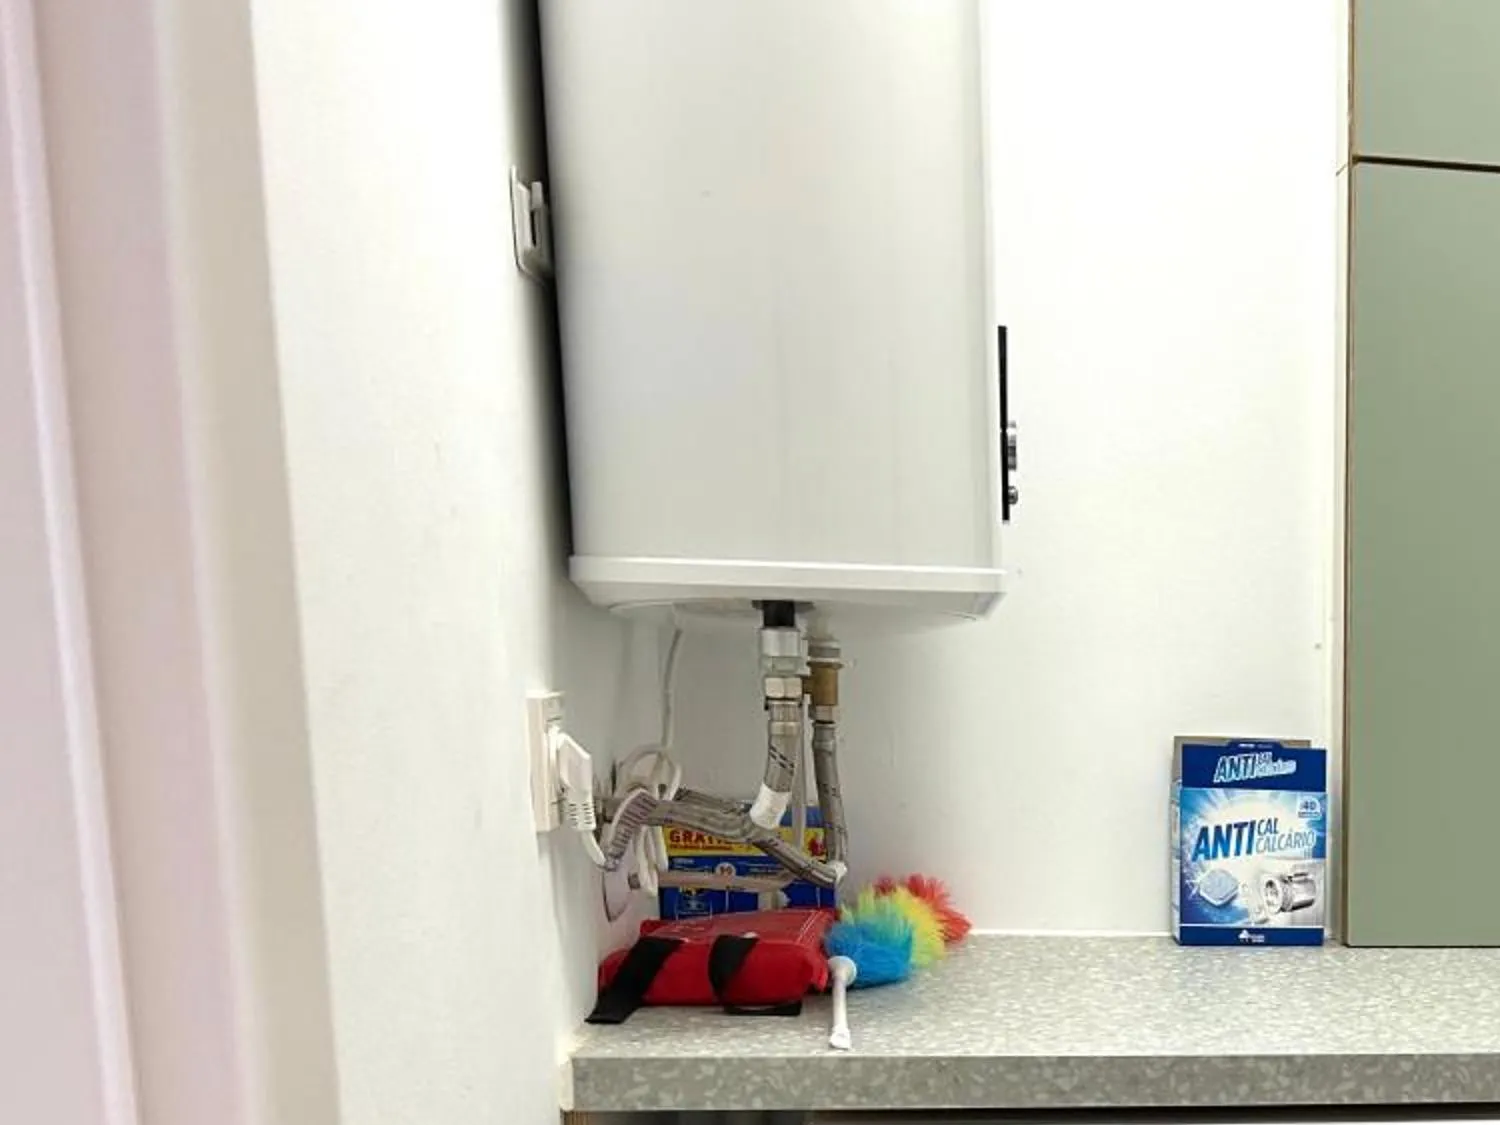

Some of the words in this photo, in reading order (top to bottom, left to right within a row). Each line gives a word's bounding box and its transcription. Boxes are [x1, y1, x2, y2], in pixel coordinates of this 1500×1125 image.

[1213, 753, 1258, 782] ANTI
[1192, 820, 1256, 861] ANTI
[1257, 818, 1279, 836] CAL
